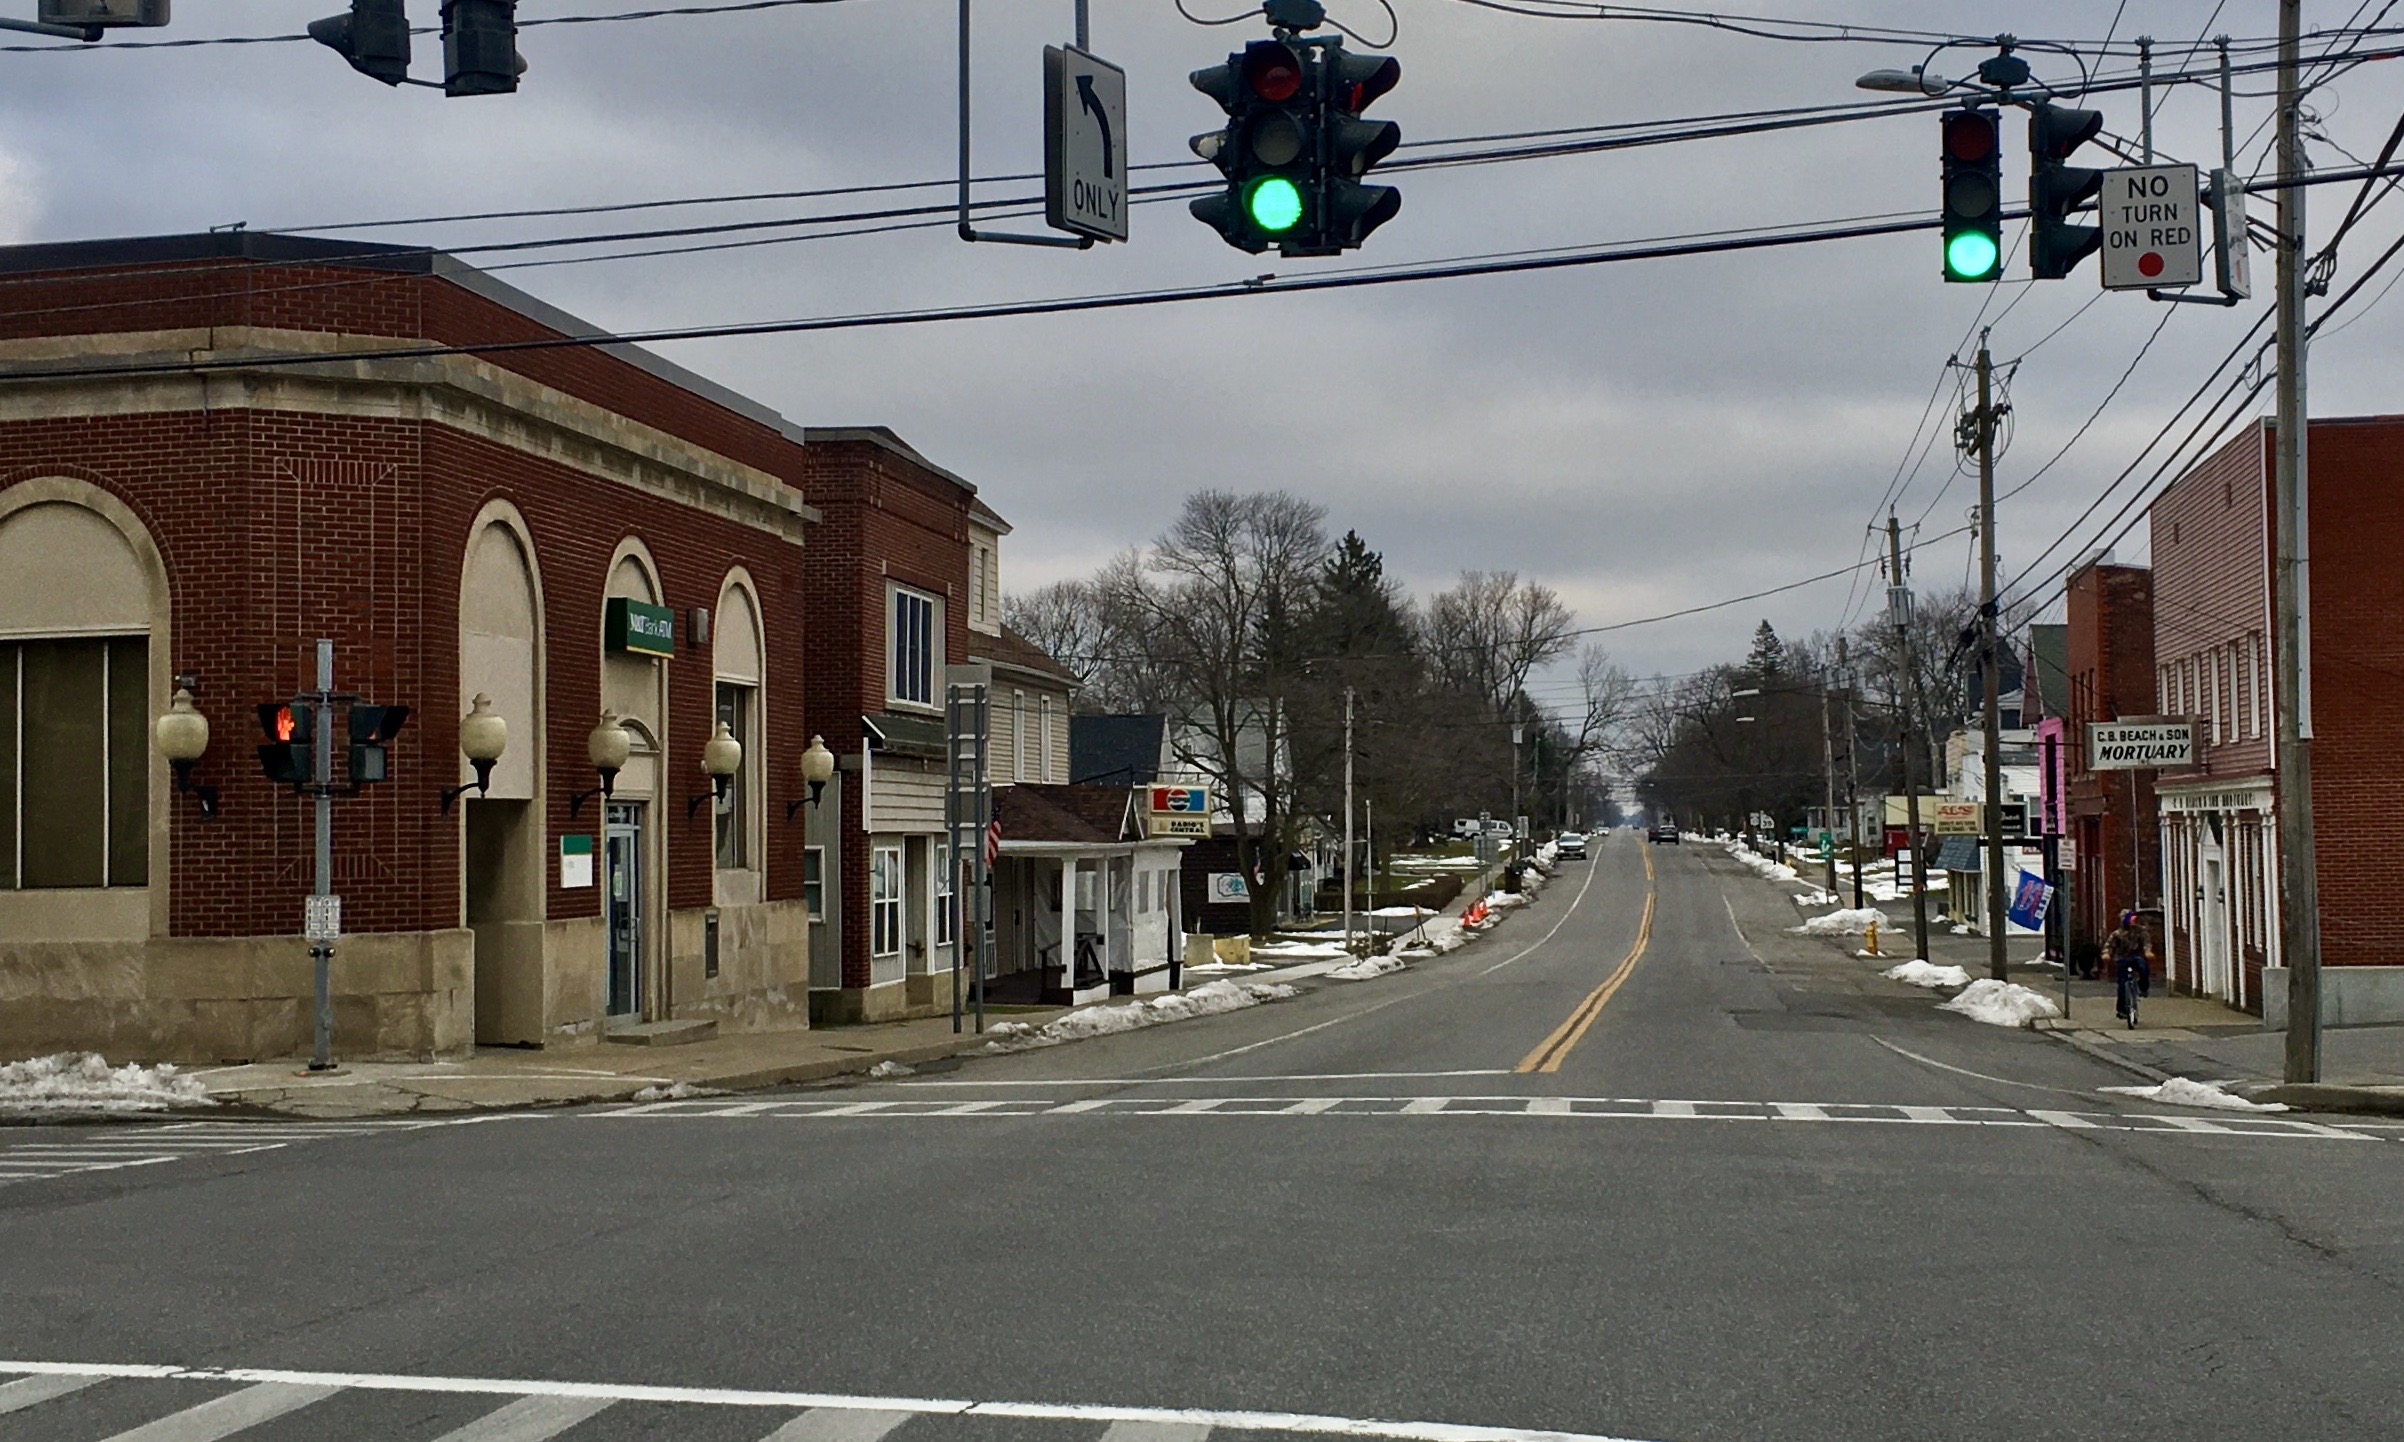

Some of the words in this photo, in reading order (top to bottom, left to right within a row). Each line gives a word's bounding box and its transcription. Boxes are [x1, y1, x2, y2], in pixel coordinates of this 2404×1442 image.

[2128, 175, 2169, 199] NO
[1074, 178, 1119, 222] ONLY
[2121, 202, 2178, 224] TURN
[2110, 230, 2138, 249] ON
[2151, 227, 2191, 247] RED
[2119, 729, 2157, 742] BEACH
[2166, 728, 2190, 741] SON
[2099, 743, 2191, 761] MORTUARY
